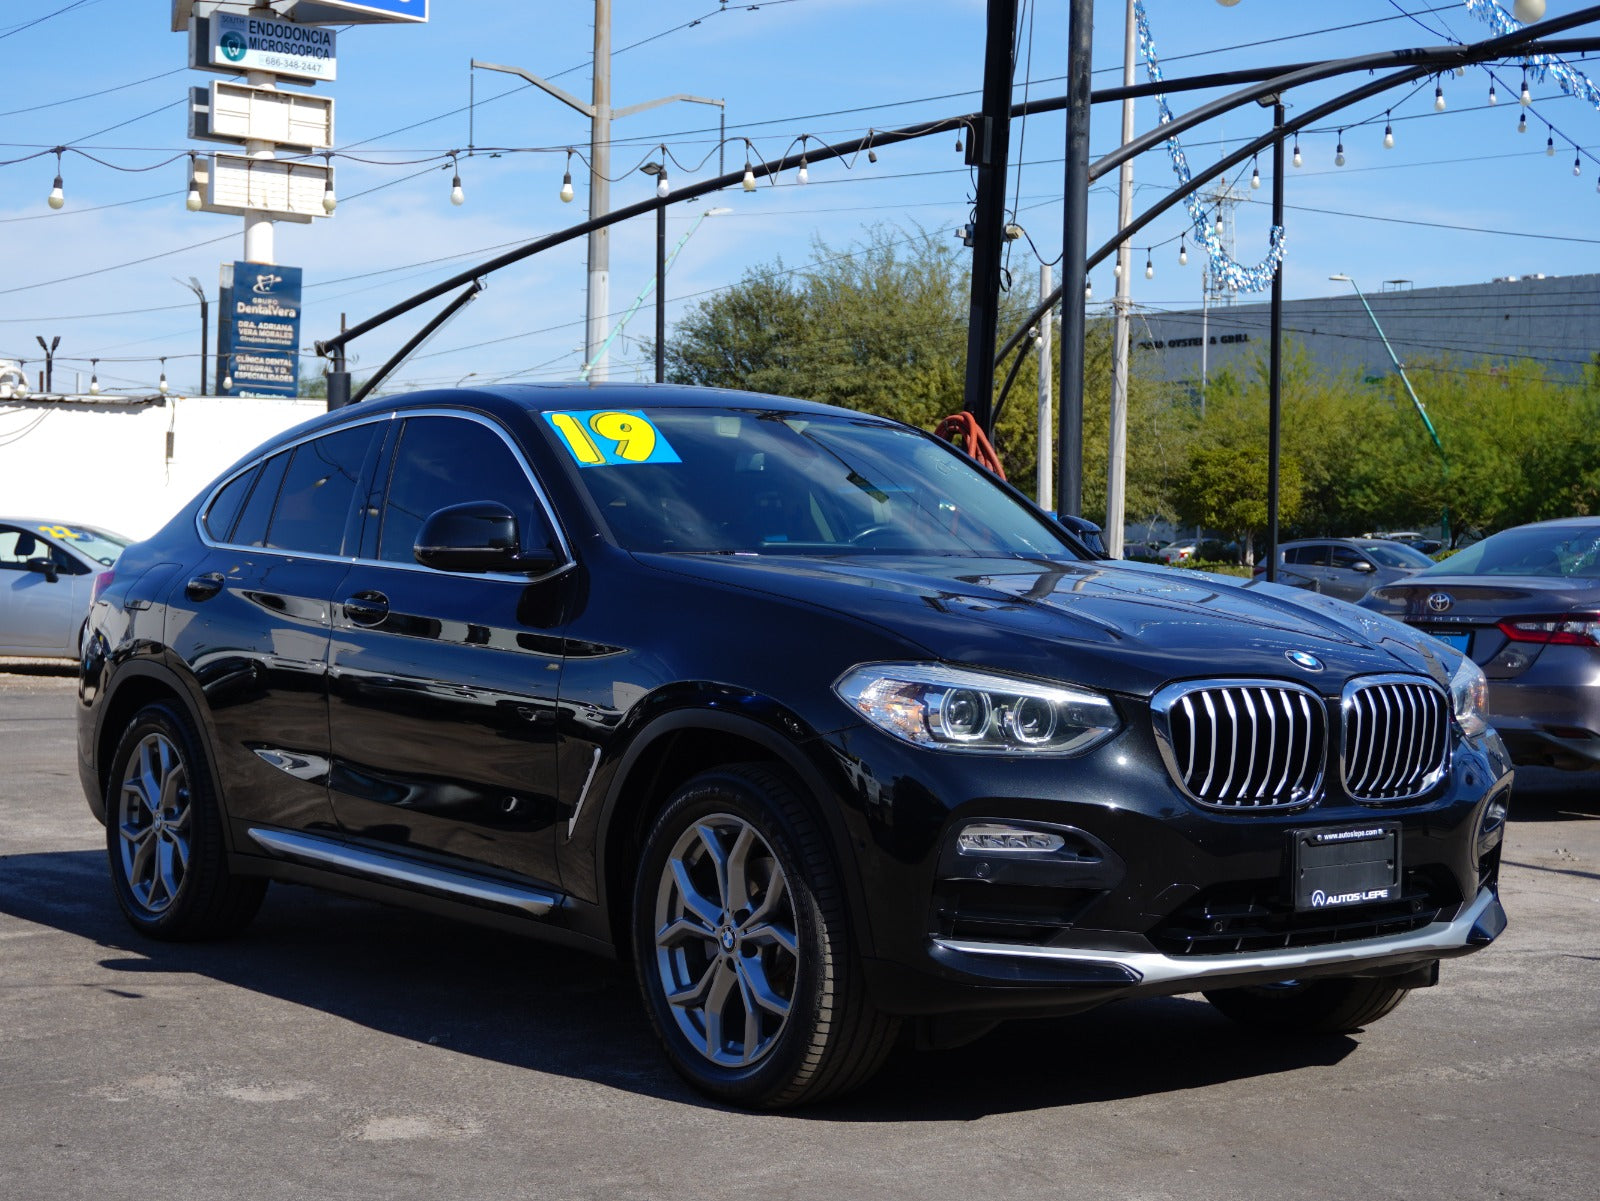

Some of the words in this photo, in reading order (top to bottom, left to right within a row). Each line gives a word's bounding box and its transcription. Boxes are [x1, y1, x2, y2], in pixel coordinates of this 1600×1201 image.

[249, 20, 331, 46] ENDODONCIA
[249, 37, 330, 61] MICROSCOPICA
[265, 57, 322, 72] 686-348-2447
[252, 297, 278, 305] GRUPO
[237, 301, 297, 317] DentalVera
[238, 320, 257, 329] DRA.
[258, 322, 293, 331] ADRIANA
[239, 328, 258, 336] VERA
[259, 330, 294, 339] MORALES
[1220, 333, 1250, 344] GRILL
[265, 357, 293, 367] DENTAL
[238, 364, 273, 374] INTEGRAL
[234, 371, 294, 382] ESPECIALIDADES
[551, 411, 656, 464] 19
[38, 525, 80, 538] 22
[1323, 829, 1378, 840] www.autoslepe.com
